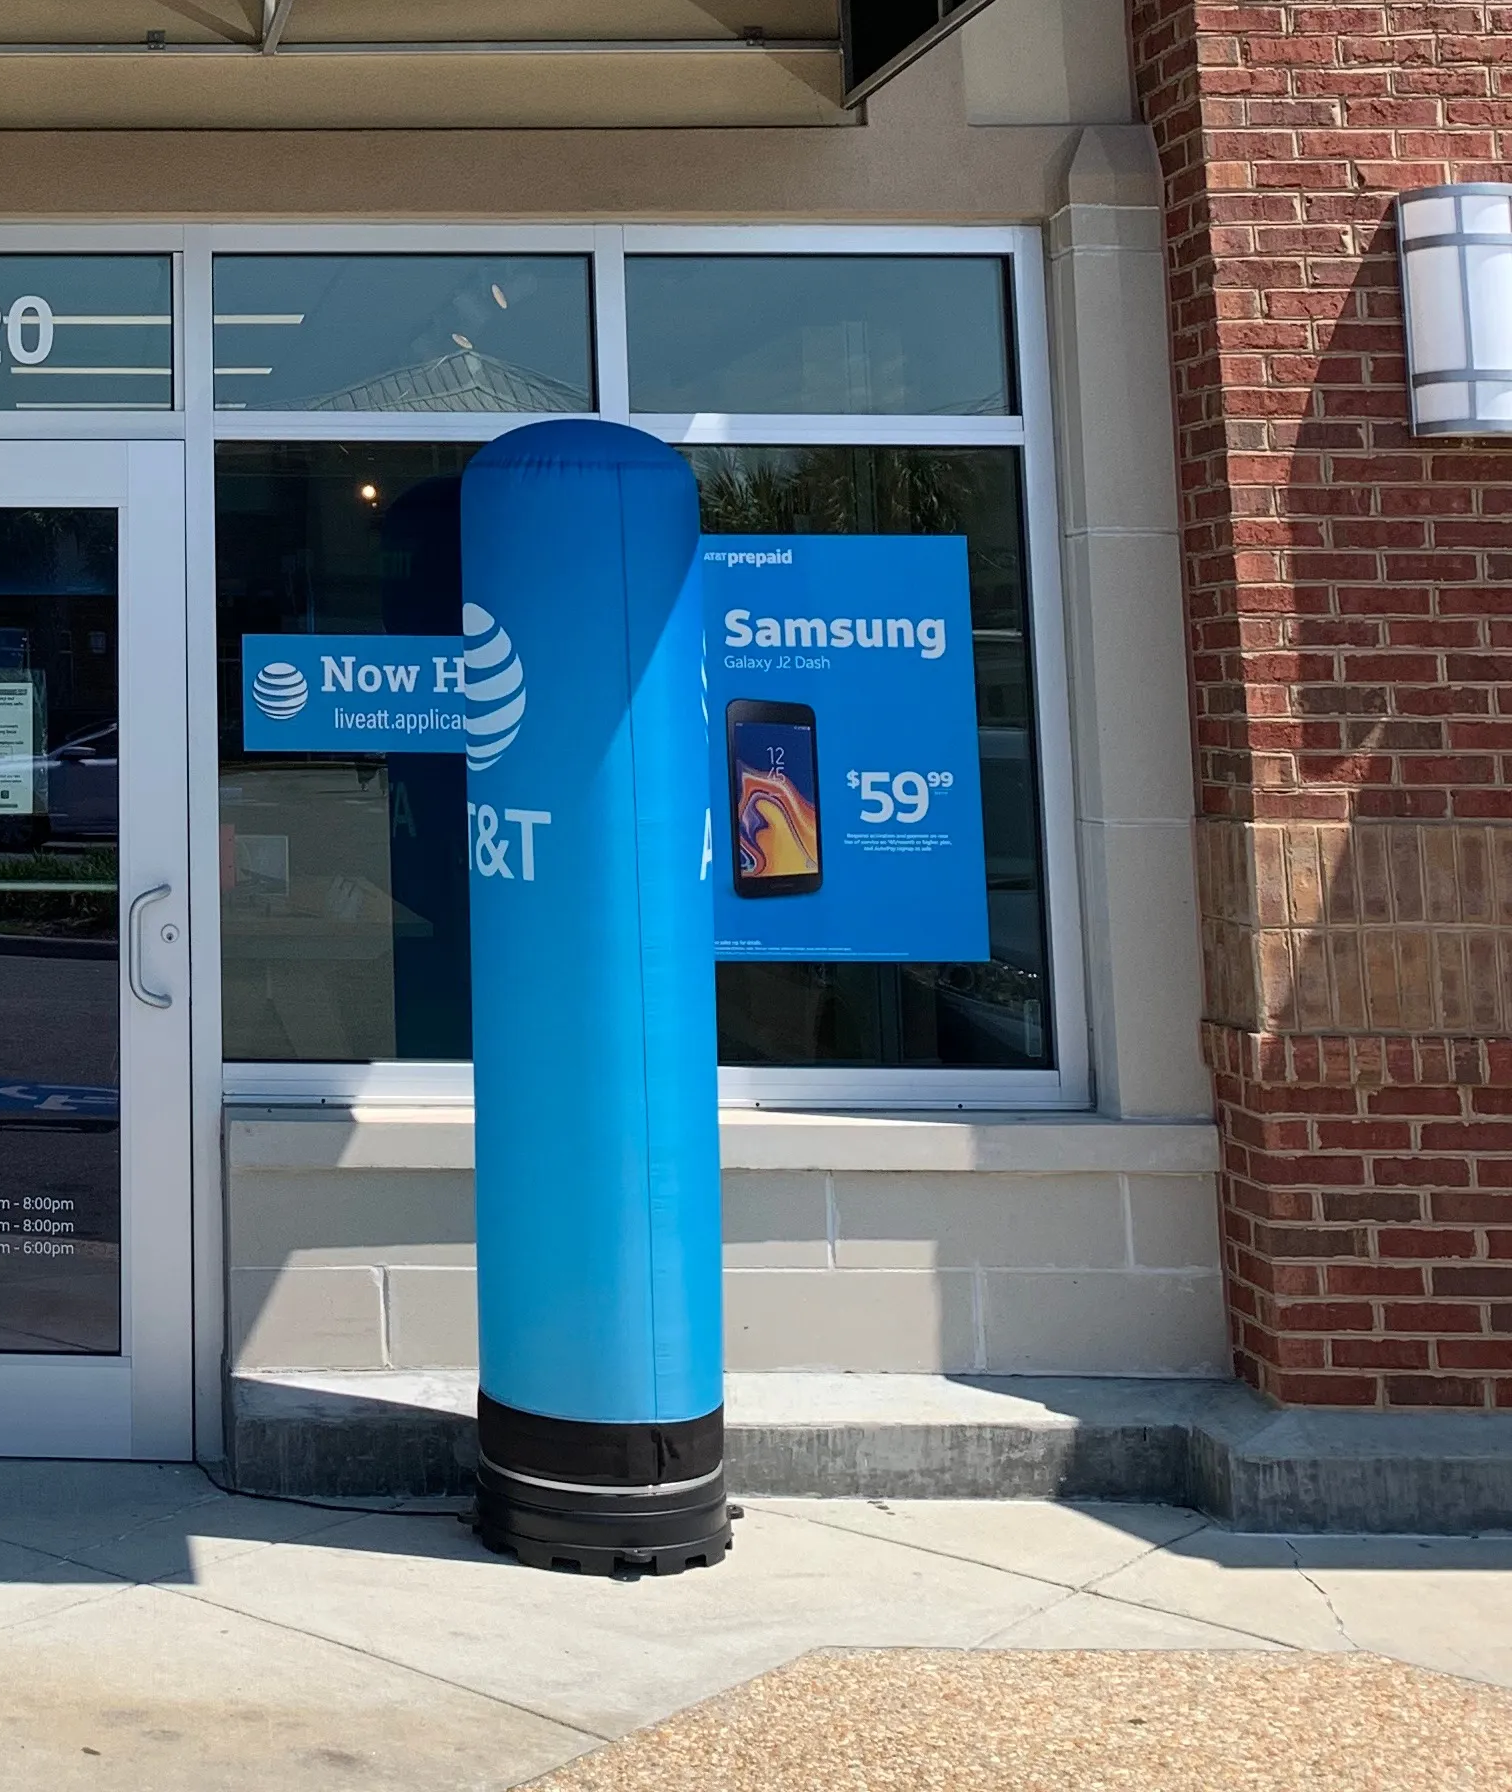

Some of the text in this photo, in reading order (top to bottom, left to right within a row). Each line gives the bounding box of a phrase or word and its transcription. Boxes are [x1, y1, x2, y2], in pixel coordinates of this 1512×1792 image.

[728, 548, 792, 568] prepaid
[724, 609, 946, 659] Samsung
[724, 656, 831, 672] Galaxy J2 Dash
[320, 656, 420, 692] Now
[766, 746, 784, 765] 12
[23, 1197, 74, 1212] 8:00pm
[23, 1219, 74, 1234] 8:00pm
[23, 1241, 74, 1257] 6:00pm
